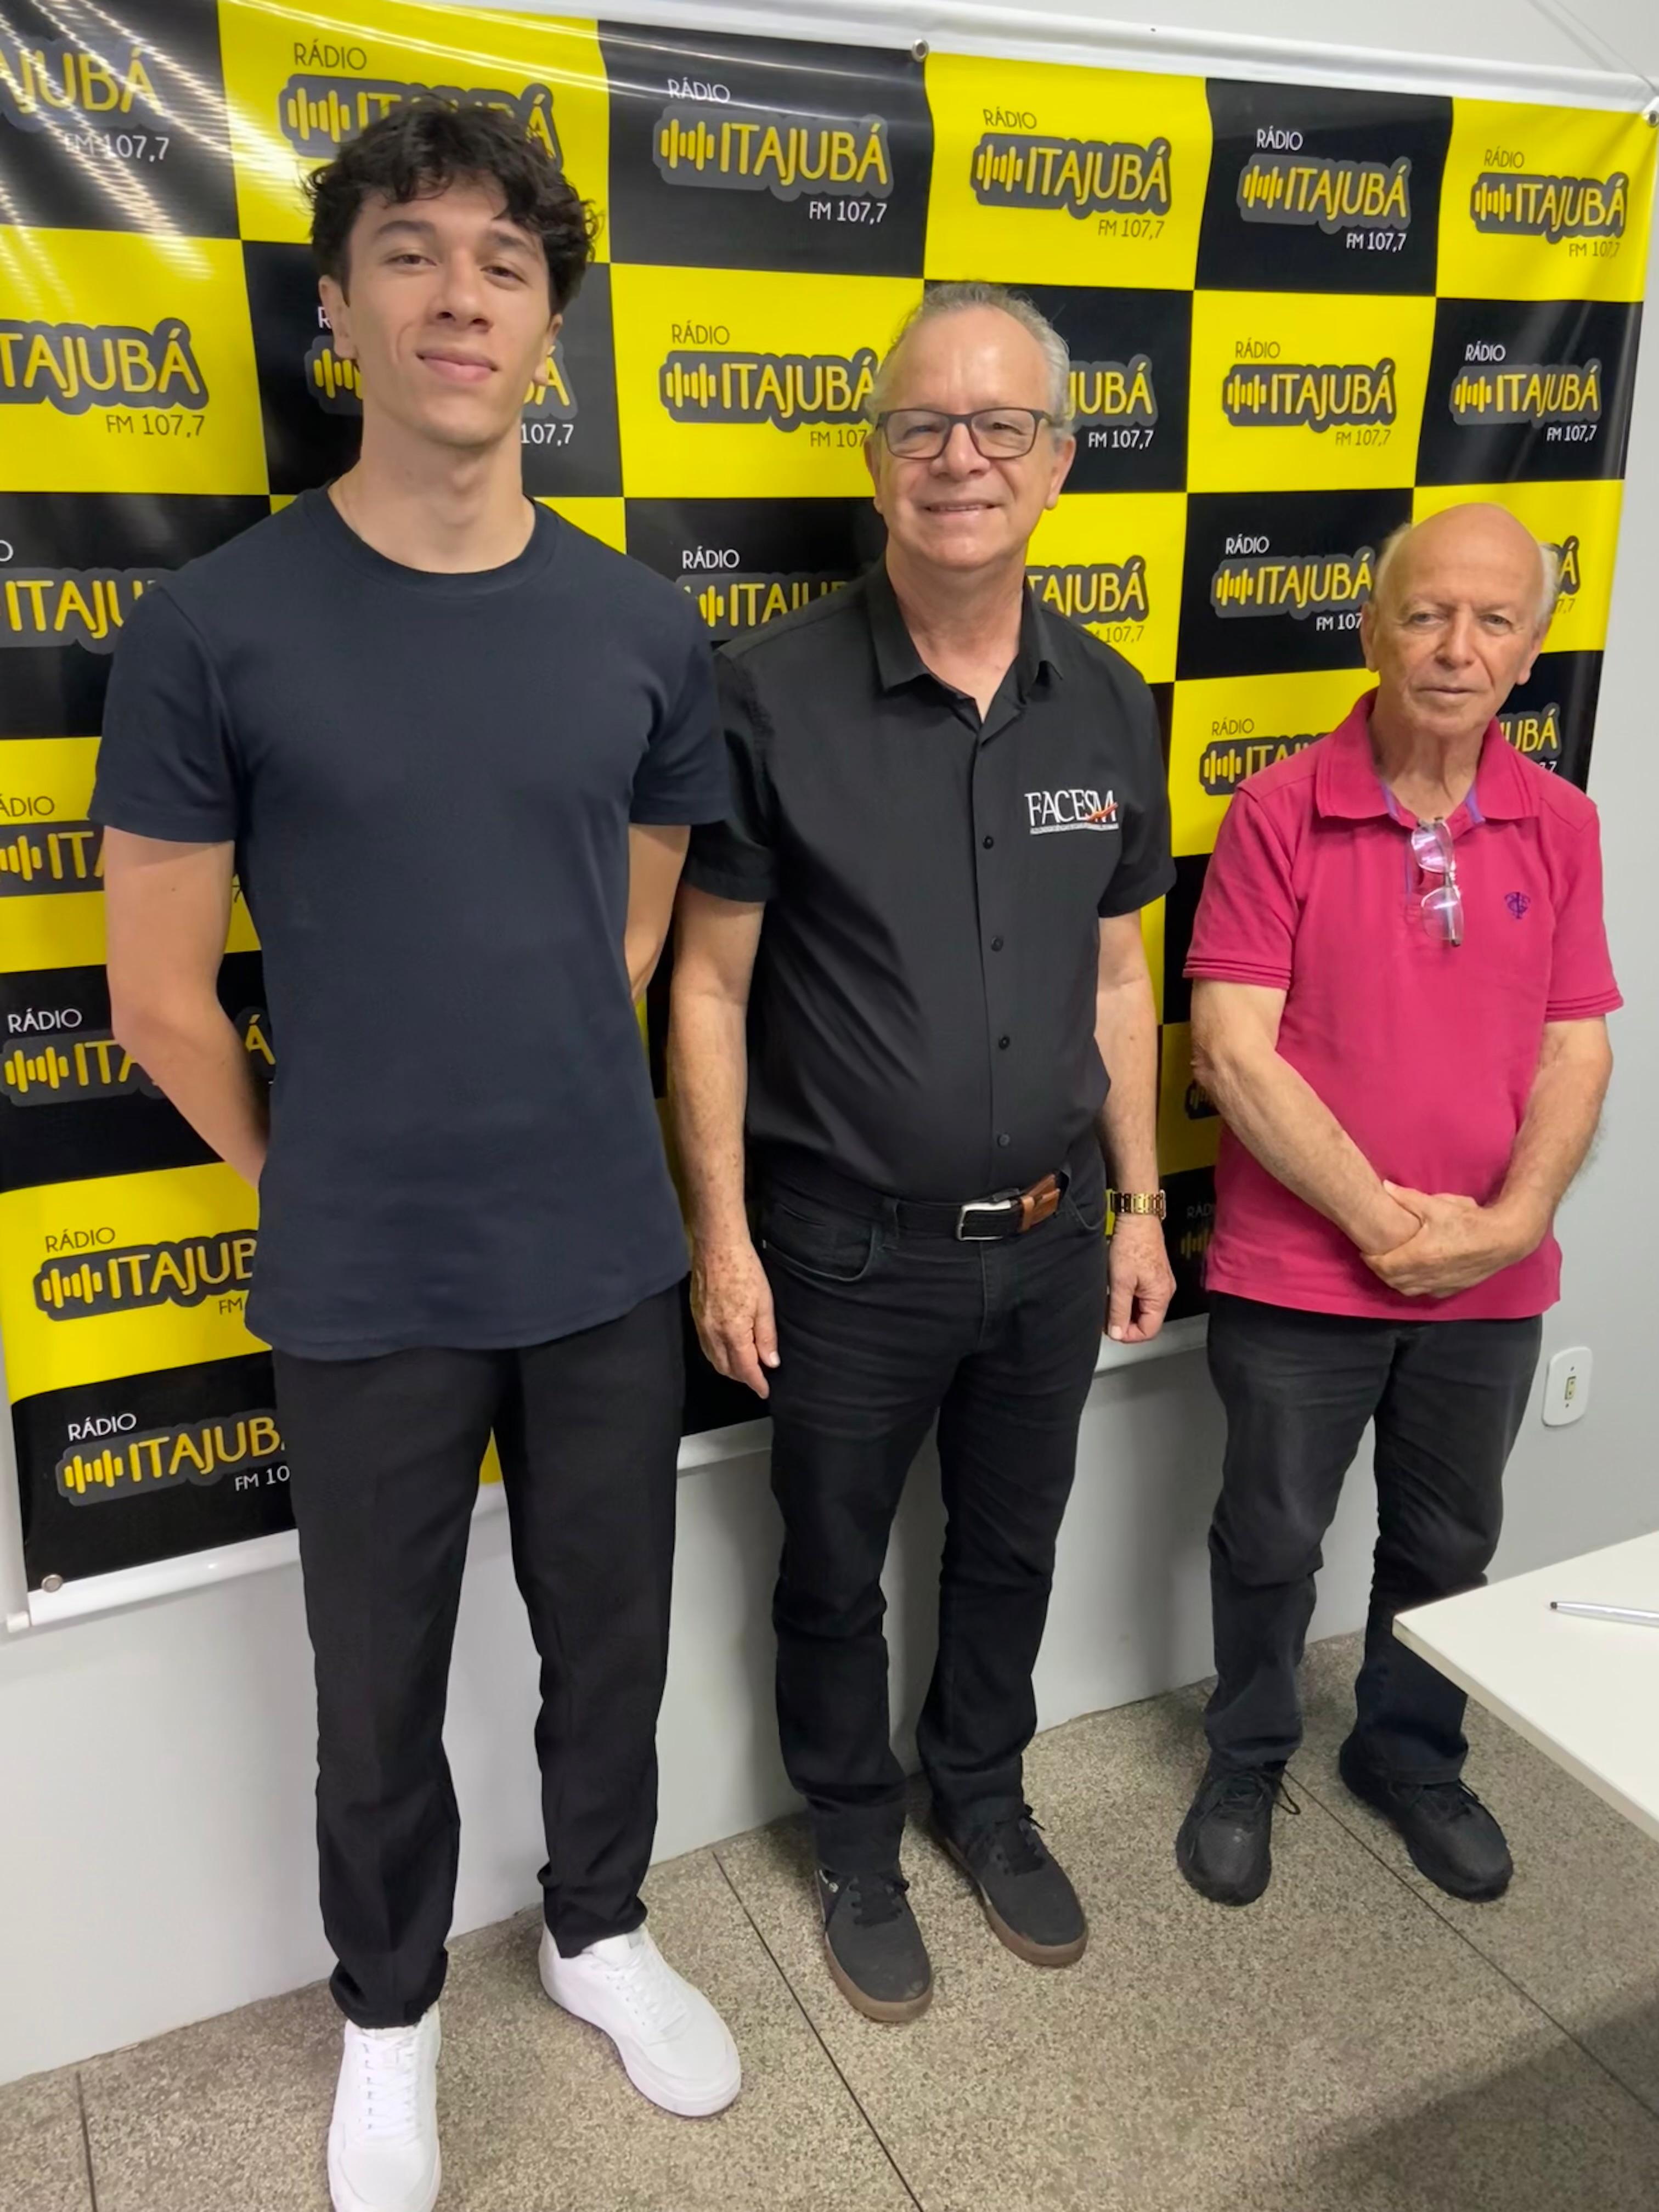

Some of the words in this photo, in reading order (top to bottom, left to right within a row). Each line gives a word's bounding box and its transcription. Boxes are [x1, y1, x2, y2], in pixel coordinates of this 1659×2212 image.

[294, 38, 367, 70] RÁDIO
[667, 77, 731, 104] RÁDIO
[983, 106, 1037, 129] RÁDIO
[1256, 127, 1303, 151] RÁDIO
[720, 121, 888, 187] ITAJUBÁ
[1484, 146, 1525, 169] RÁDIO
[1026, 145, 1169, 206] ITAJUBÁ
[1285, 165, 1408, 221] ITAJUBÁ
[809, 201, 832, 220] FM
[837, 201, 888, 224] 107,7
[1515, 177, 1626, 233] ITAJUBÁ
[1098, 219, 1117, 236] FM
[1121, 219, 1165, 240] 107,7
[1346, 234, 1363, 249] FM
[1368, 234, 1407, 252] 107,7
[1569, 242, 1587, 257] FM
[672, 320, 730, 345] RÁDIO
[1235, 337, 1280, 359] RÁDIO
[1465, 342, 1506, 362] RÁDIO
[722, 356, 874, 419] ITAJUBÁ
[1271, 366, 1393, 420] ITAJUBÁ
[1496, 365, 1599, 419] ITAJUBÁ
[106, 414, 133, 433] FM
[143, 414, 205, 438] 107,7
[1547, 426, 1562, 441] FM
[1565, 425, 1597, 443] 107,7
[811, 431, 831, 448] FM
[1088, 432, 1107, 448] FM
[1111, 430, 1154, 449] 107,7
[1335, 431, 1352, 445] FM
[1355, 430, 1391, 448] 107,7
[1226, 534, 1269, 555] RÁDIO
[682, 546, 740, 569] RÁDIO
[1256, 552, 1372, 608] ITAJUBÁ
[1316, 616, 1334, 631] FM
[1211, 718, 1255, 736] RÁDIO
[1025, 789, 1116, 826] FACESM
[8, 1008, 82, 1034] RÁDIO
[45, 1227, 115, 1254] RÁDIO
[219, 1297, 243, 1315] FM
[67, 1413, 137, 1442] RÁDIO
[128, 1417, 285, 1482] ITAJUB
[234, 1472, 260, 1492] FM
